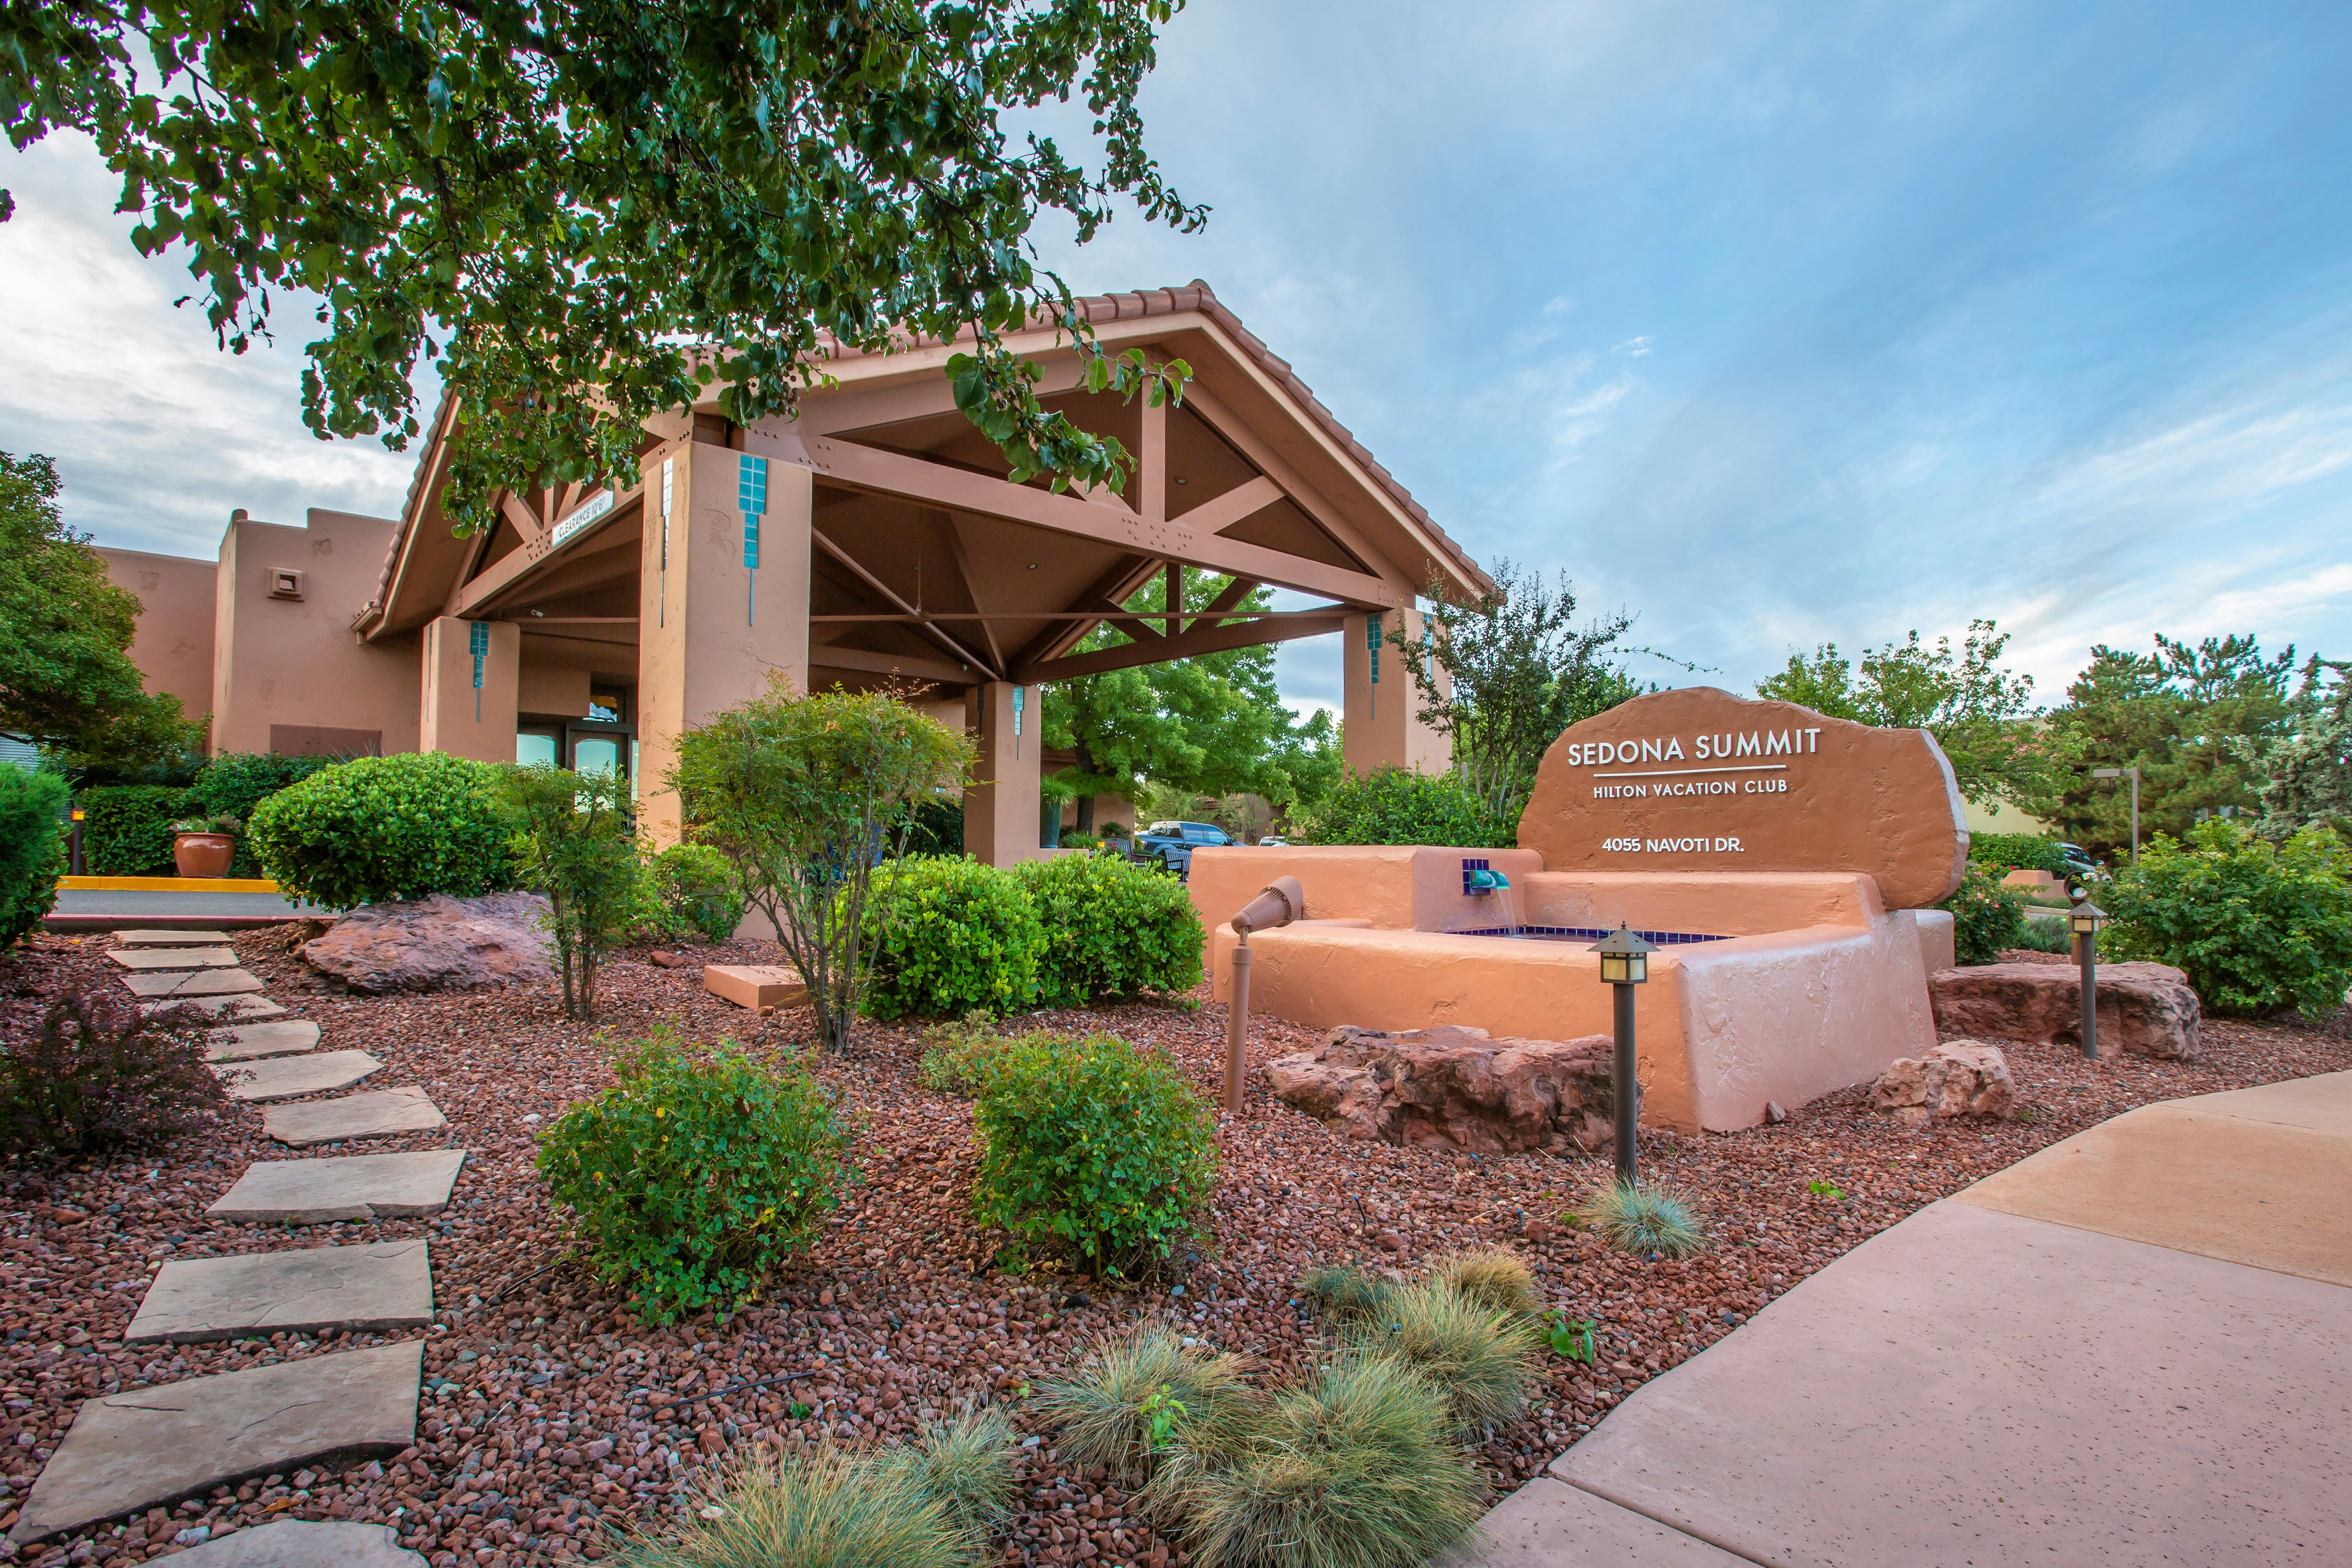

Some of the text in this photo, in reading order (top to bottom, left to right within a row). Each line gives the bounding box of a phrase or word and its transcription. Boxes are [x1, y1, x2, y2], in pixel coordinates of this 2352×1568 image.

[559, 507, 590, 537] CLEARANCE
[1569, 728, 1821, 766] SEDONA SUMMIT
[1594, 780, 1788, 799] HILTON VACATION CLUB
[1602, 838, 1745, 853] 4055 NAVOTI DR.
